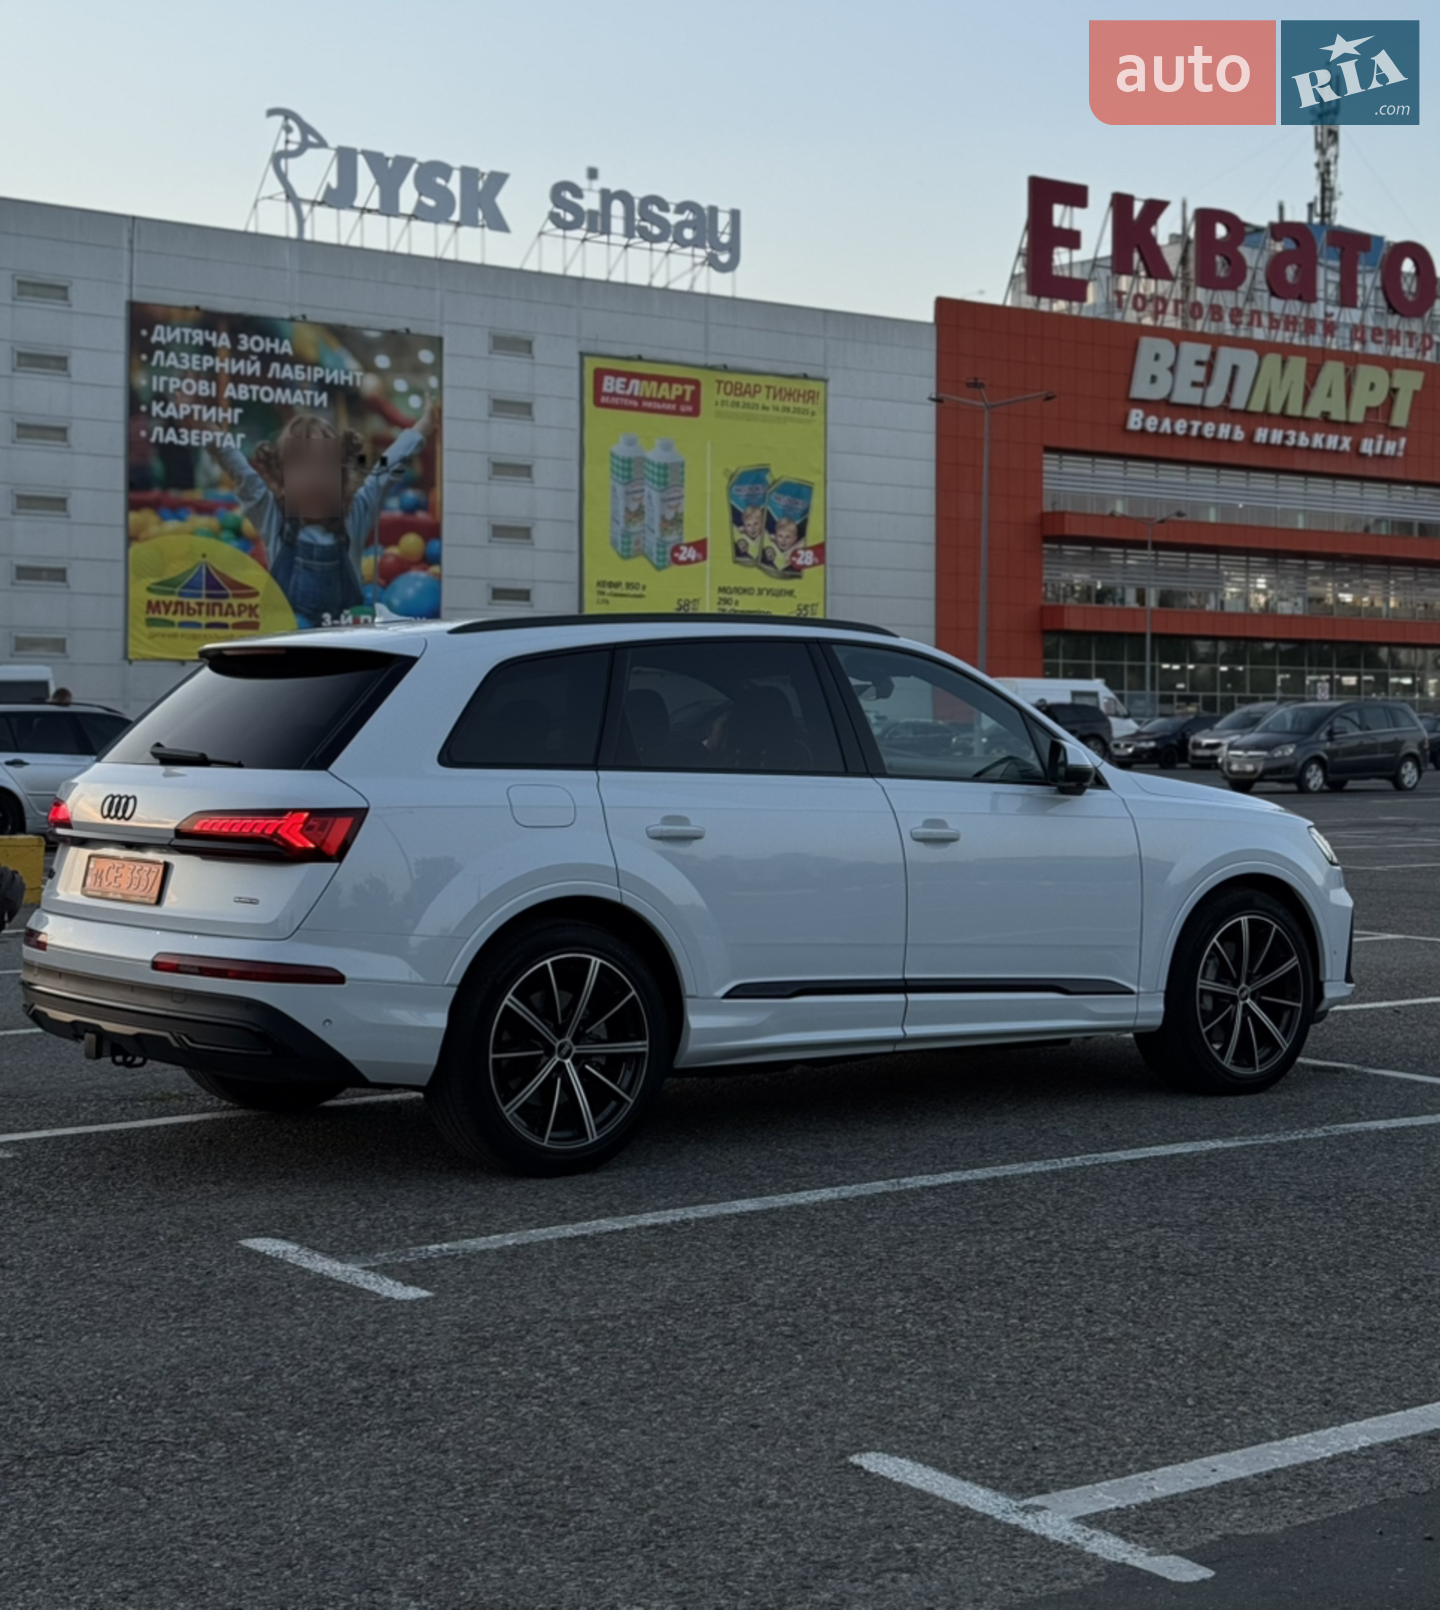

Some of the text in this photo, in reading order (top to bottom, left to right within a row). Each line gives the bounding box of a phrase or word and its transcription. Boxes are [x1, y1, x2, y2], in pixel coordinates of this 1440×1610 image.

[322, 145, 511, 234] JYSK
[548, 166, 742, 273] sinsay
[1114, 288, 1434, 355] торговельний центр
[151, 324, 293, 355] ДИТЯЧА ЗОНА
[151, 350, 363, 388] ЛАЗЕРНИЙ ЛАБІРИНТ
[1128, 336, 1426, 429] ВЕЛМАРТ
[152, 375, 328, 408] ІГРОВІ АВТОМАТИ
[602, 375, 695, 402] ВЕЛМАРТ
[715, 380, 820, 406] ТОВАР ТИЖНЯ!
[152, 400, 244, 424] КАРТИНГ
[150, 426, 246, 450] ЛАЗЕРТАГ
[1126, 408, 1408, 457] Велетень низьких цін!
[717, 586, 755, 596] МОЛОКО
[146, 600, 260, 618] МУЛЬТІПАРК
